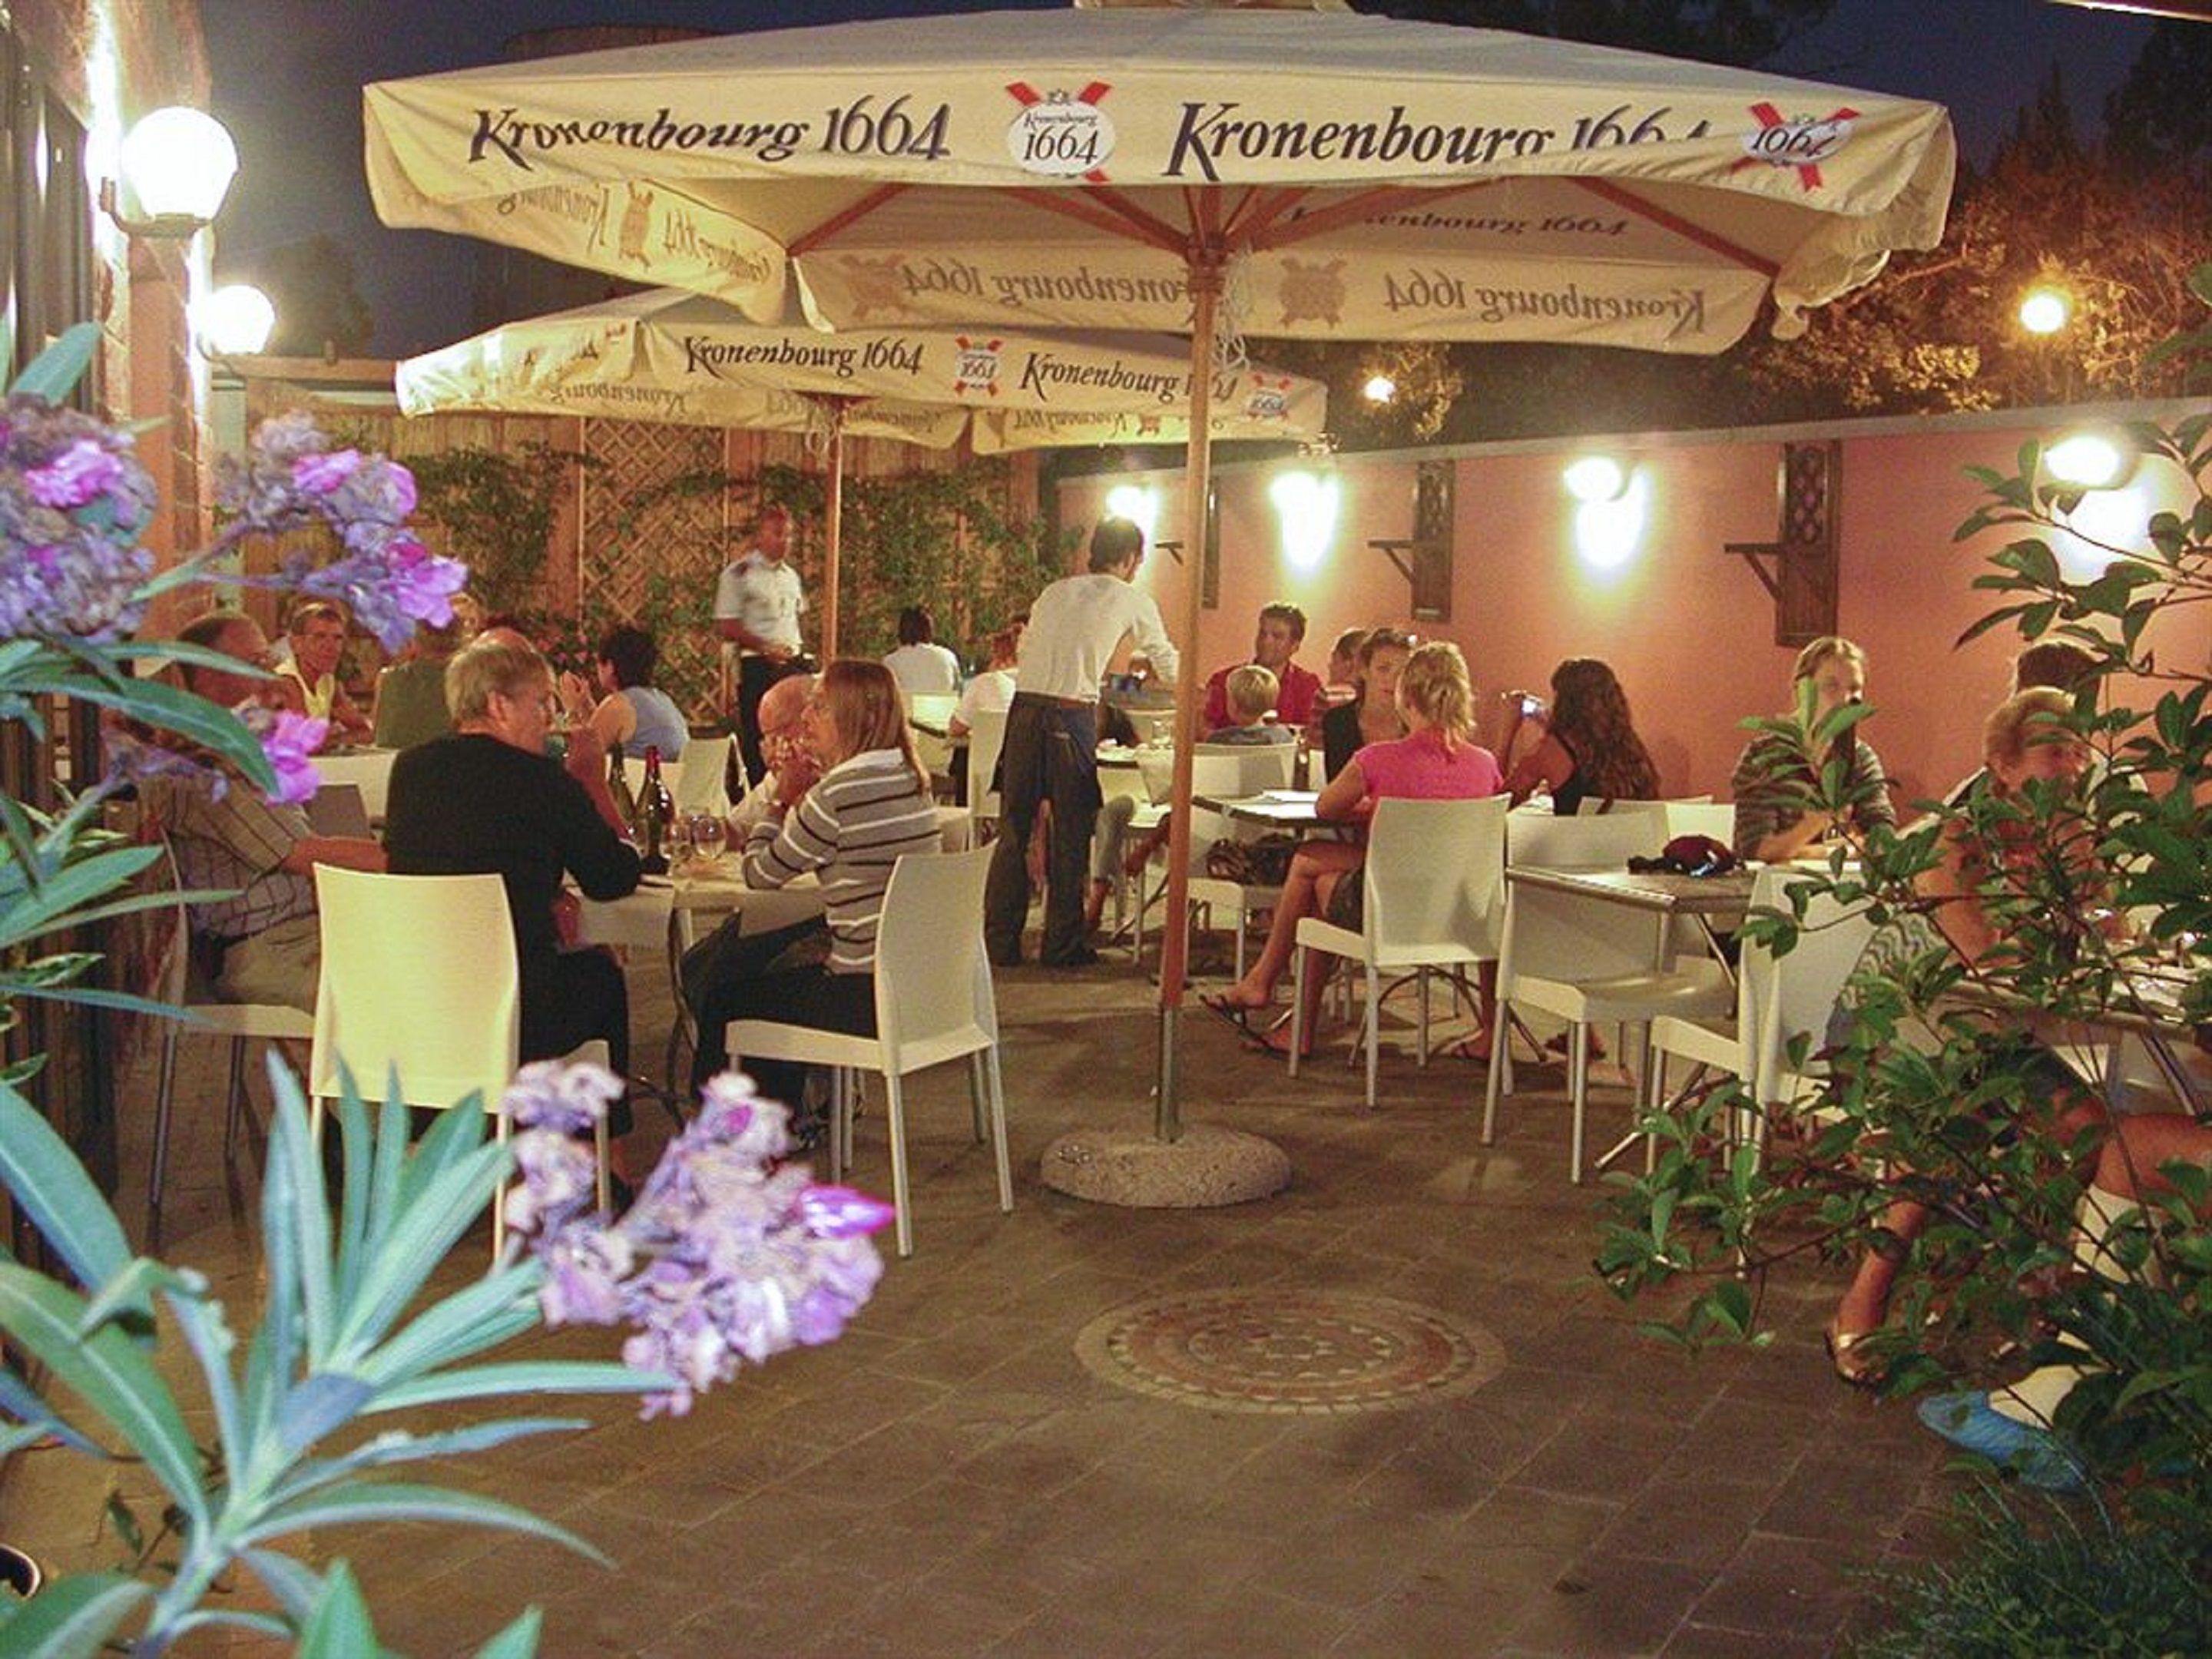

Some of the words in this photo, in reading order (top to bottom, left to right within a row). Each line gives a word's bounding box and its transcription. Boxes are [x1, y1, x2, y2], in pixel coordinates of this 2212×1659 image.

[469, 108, 811, 171] Kronenbourg
[821, 94, 951, 160] 1664
[1023, 125, 1098, 164] 1664
[1571, 104, 1710, 150] 166
[684, 336, 857, 379] Kronenbourg
[861, 336, 923, 375] 1664
[1021, 352, 1182, 406] Kronenbourg
